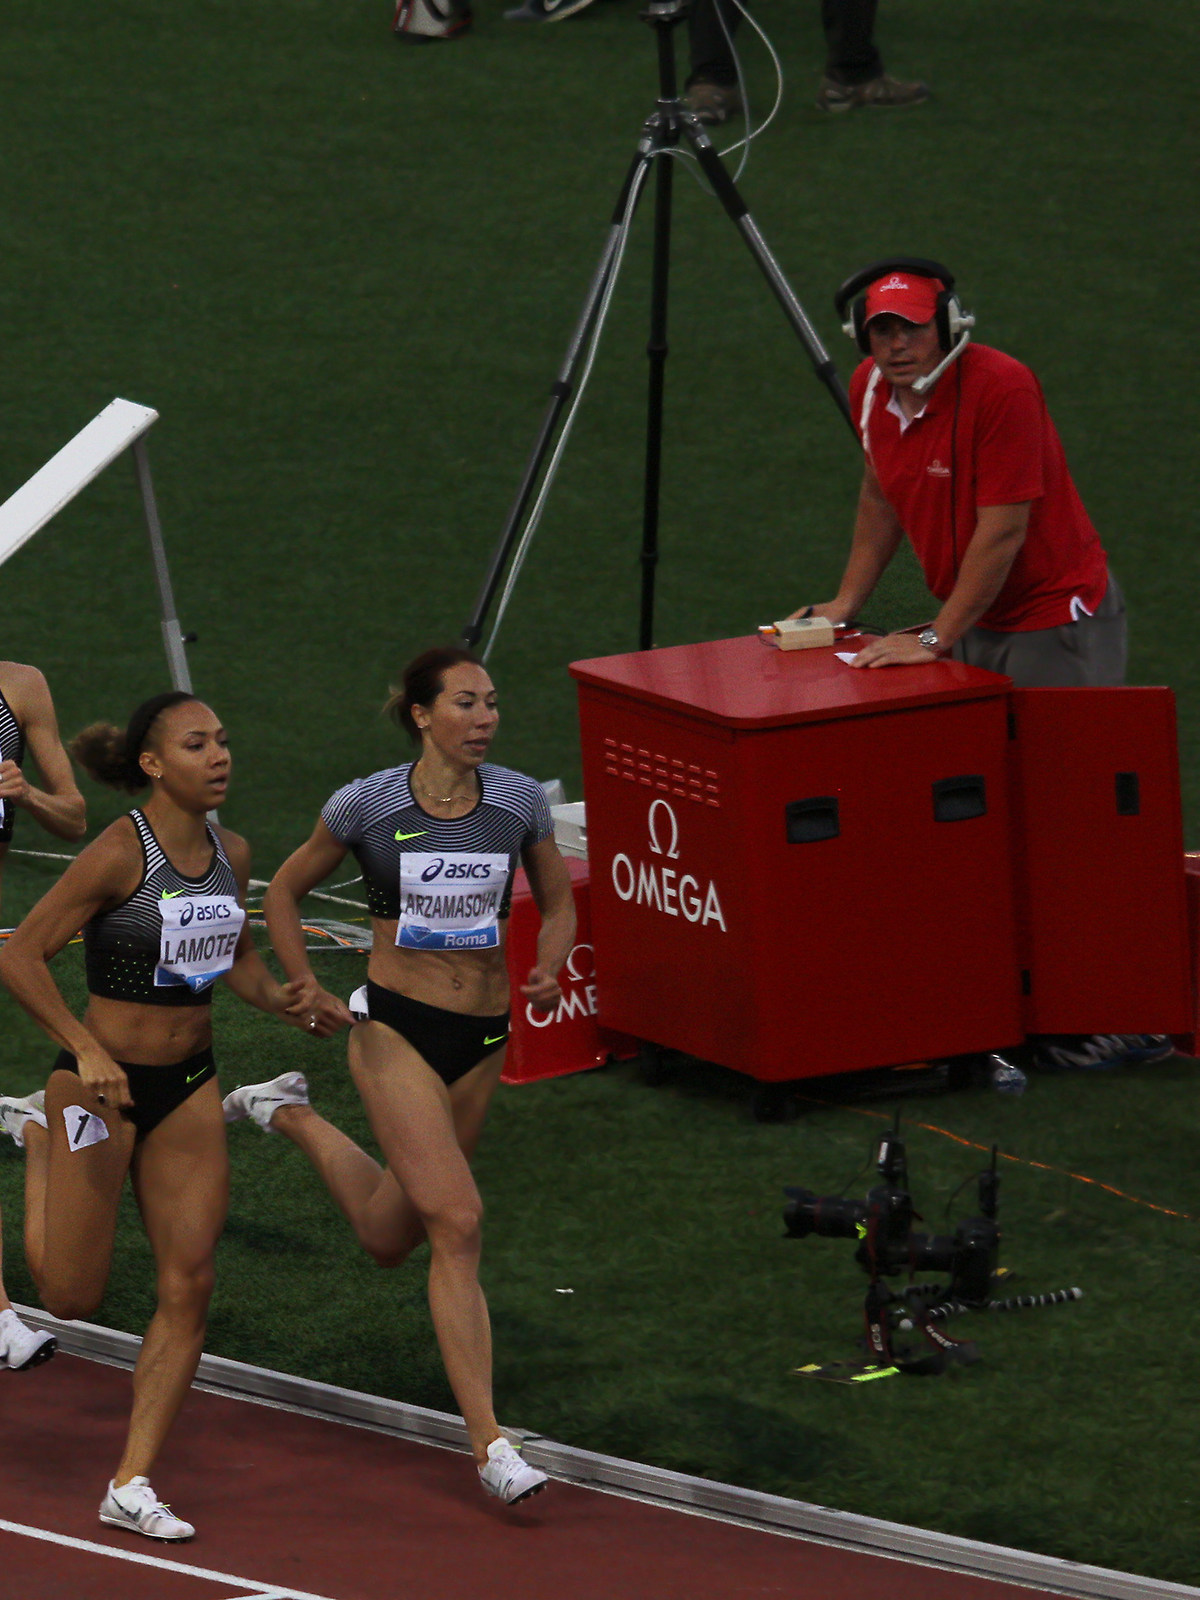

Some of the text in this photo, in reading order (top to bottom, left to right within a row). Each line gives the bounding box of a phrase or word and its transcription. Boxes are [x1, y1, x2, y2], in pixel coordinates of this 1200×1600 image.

[445, 863, 492, 879] asics
[612, 853, 728, 933] OMEGA
[197, 904, 231, 921] asics
[163, 932, 238, 965] LAMOTE
[445, 934, 488, 947] Roma
[73, 1113, 90, 1145] 1
